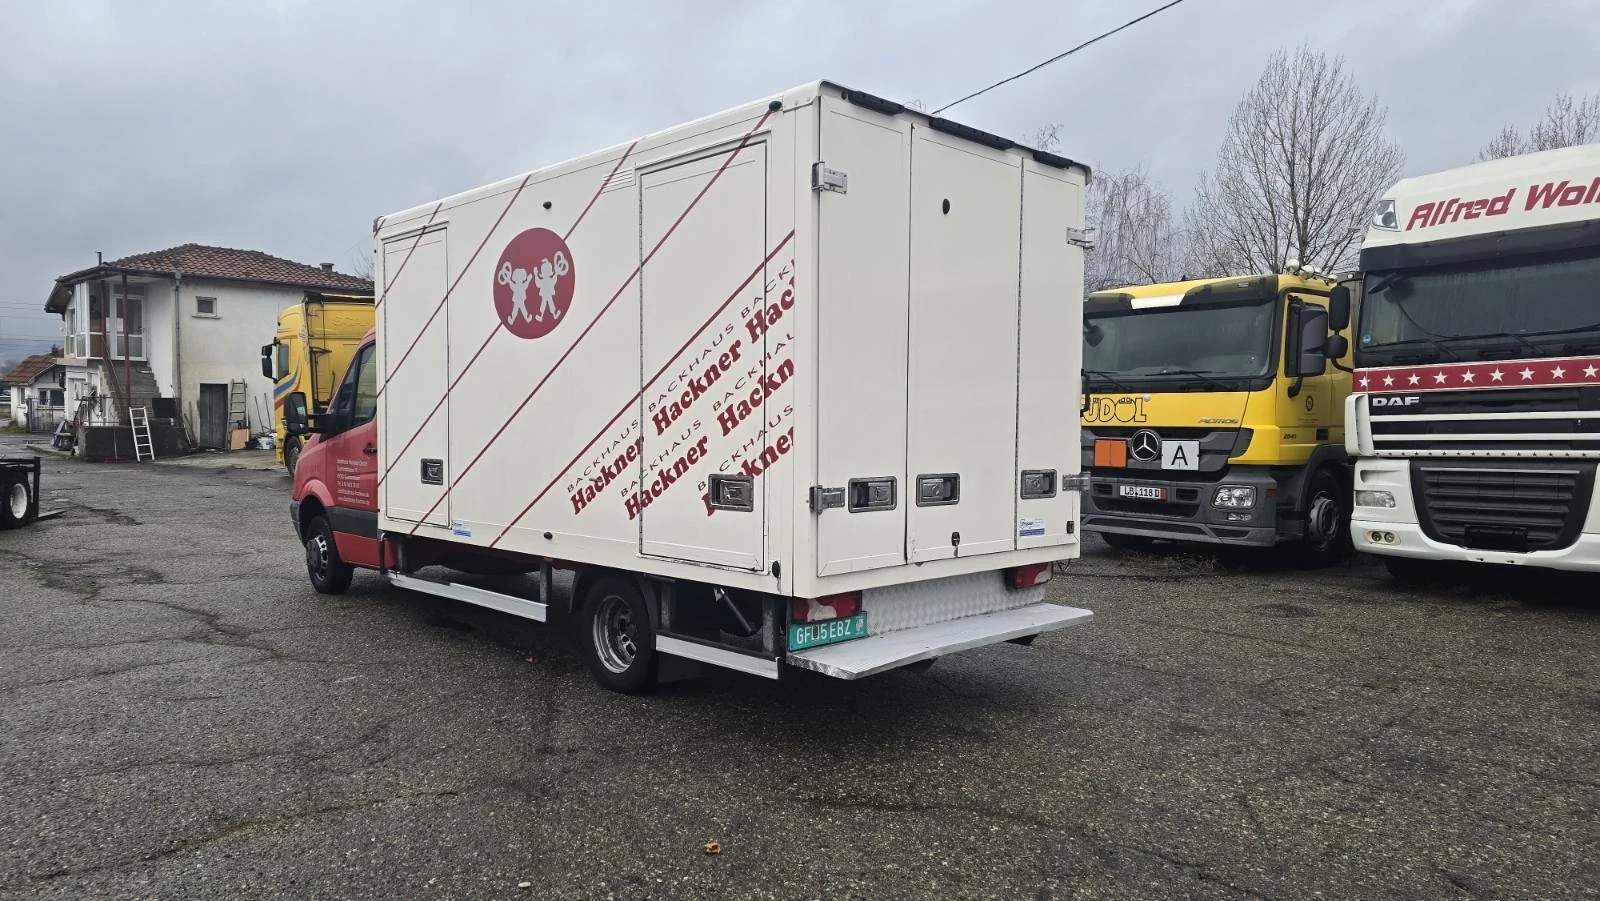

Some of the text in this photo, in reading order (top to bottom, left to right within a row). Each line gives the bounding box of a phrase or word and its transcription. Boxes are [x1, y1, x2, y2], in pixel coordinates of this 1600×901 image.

[1406, 188, 1516, 231] Alfred
[567, 259, 795, 493] BACKHAUS BACKHAUS BACK
[570, 275, 795, 515] Hackner Hackner Hac
[1372, 396, 1420, 407] DAF
[621, 419, 702, 498] BACKHAUS
[624, 435, 708, 520] Hackner
[697, 404, 794, 492] BCKHAUS
[1171, 445, 1188, 466] A
